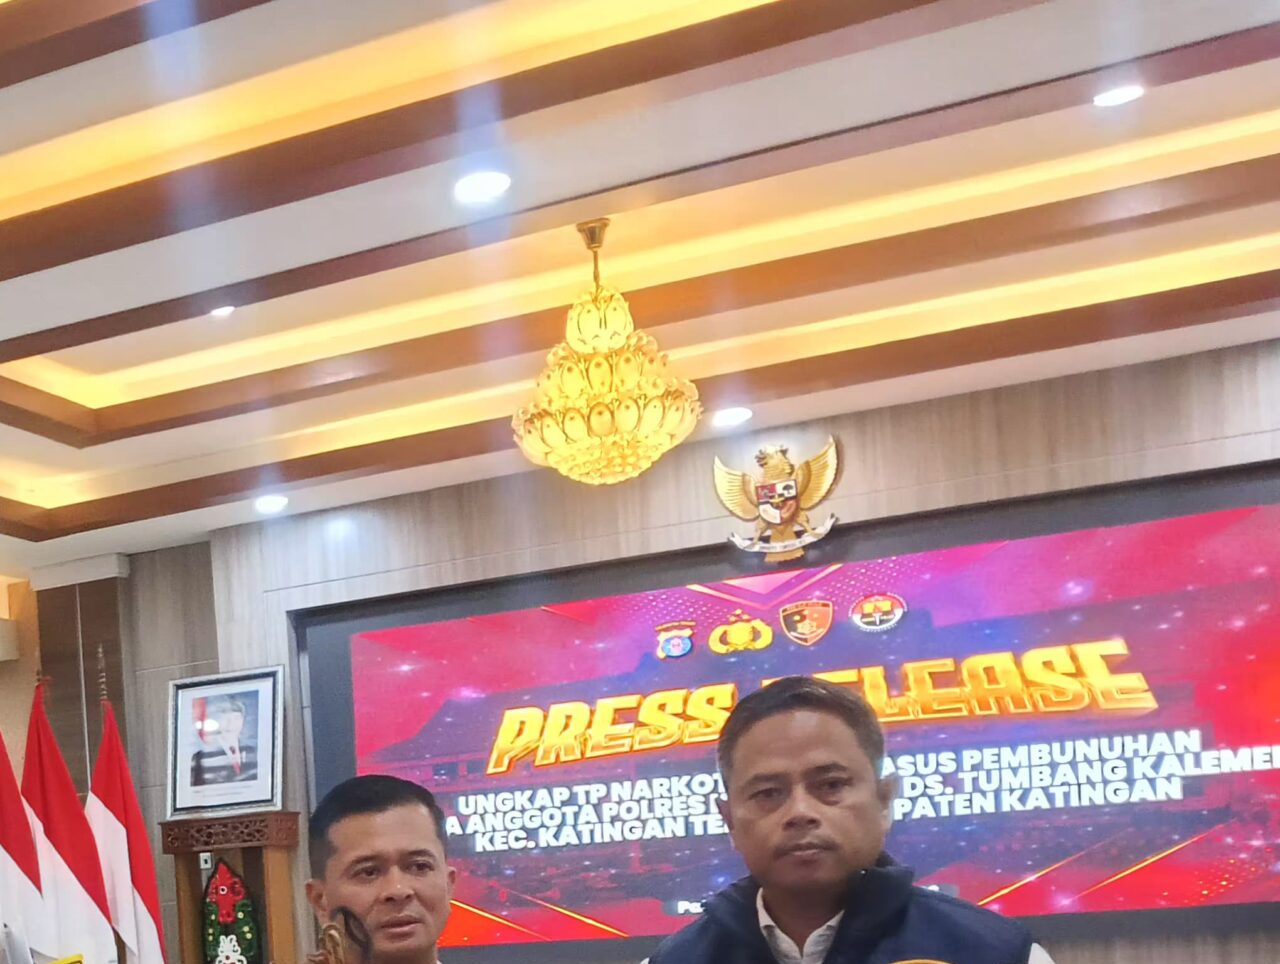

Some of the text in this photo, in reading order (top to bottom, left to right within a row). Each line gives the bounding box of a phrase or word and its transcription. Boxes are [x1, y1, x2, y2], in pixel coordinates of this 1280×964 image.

[486, 637, 1157, 775] PRESS LEASE
[458, 729, 1202, 816] UNGKAP TP NARKOT ASUS PEMBUNUHAN
[466, 805, 599, 834] ANGGOTA
[602, 793, 707, 821] POLRES
[903, 773, 955, 798] DS.
[959, 760, 1128, 793] TUMBANG
[475, 831, 536, 852] KEC.
[538, 816, 687, 848] KATINGAN
[892, 791, 996, 821] PATEN
[1001, 776, 1184, 813] KATINGAN
